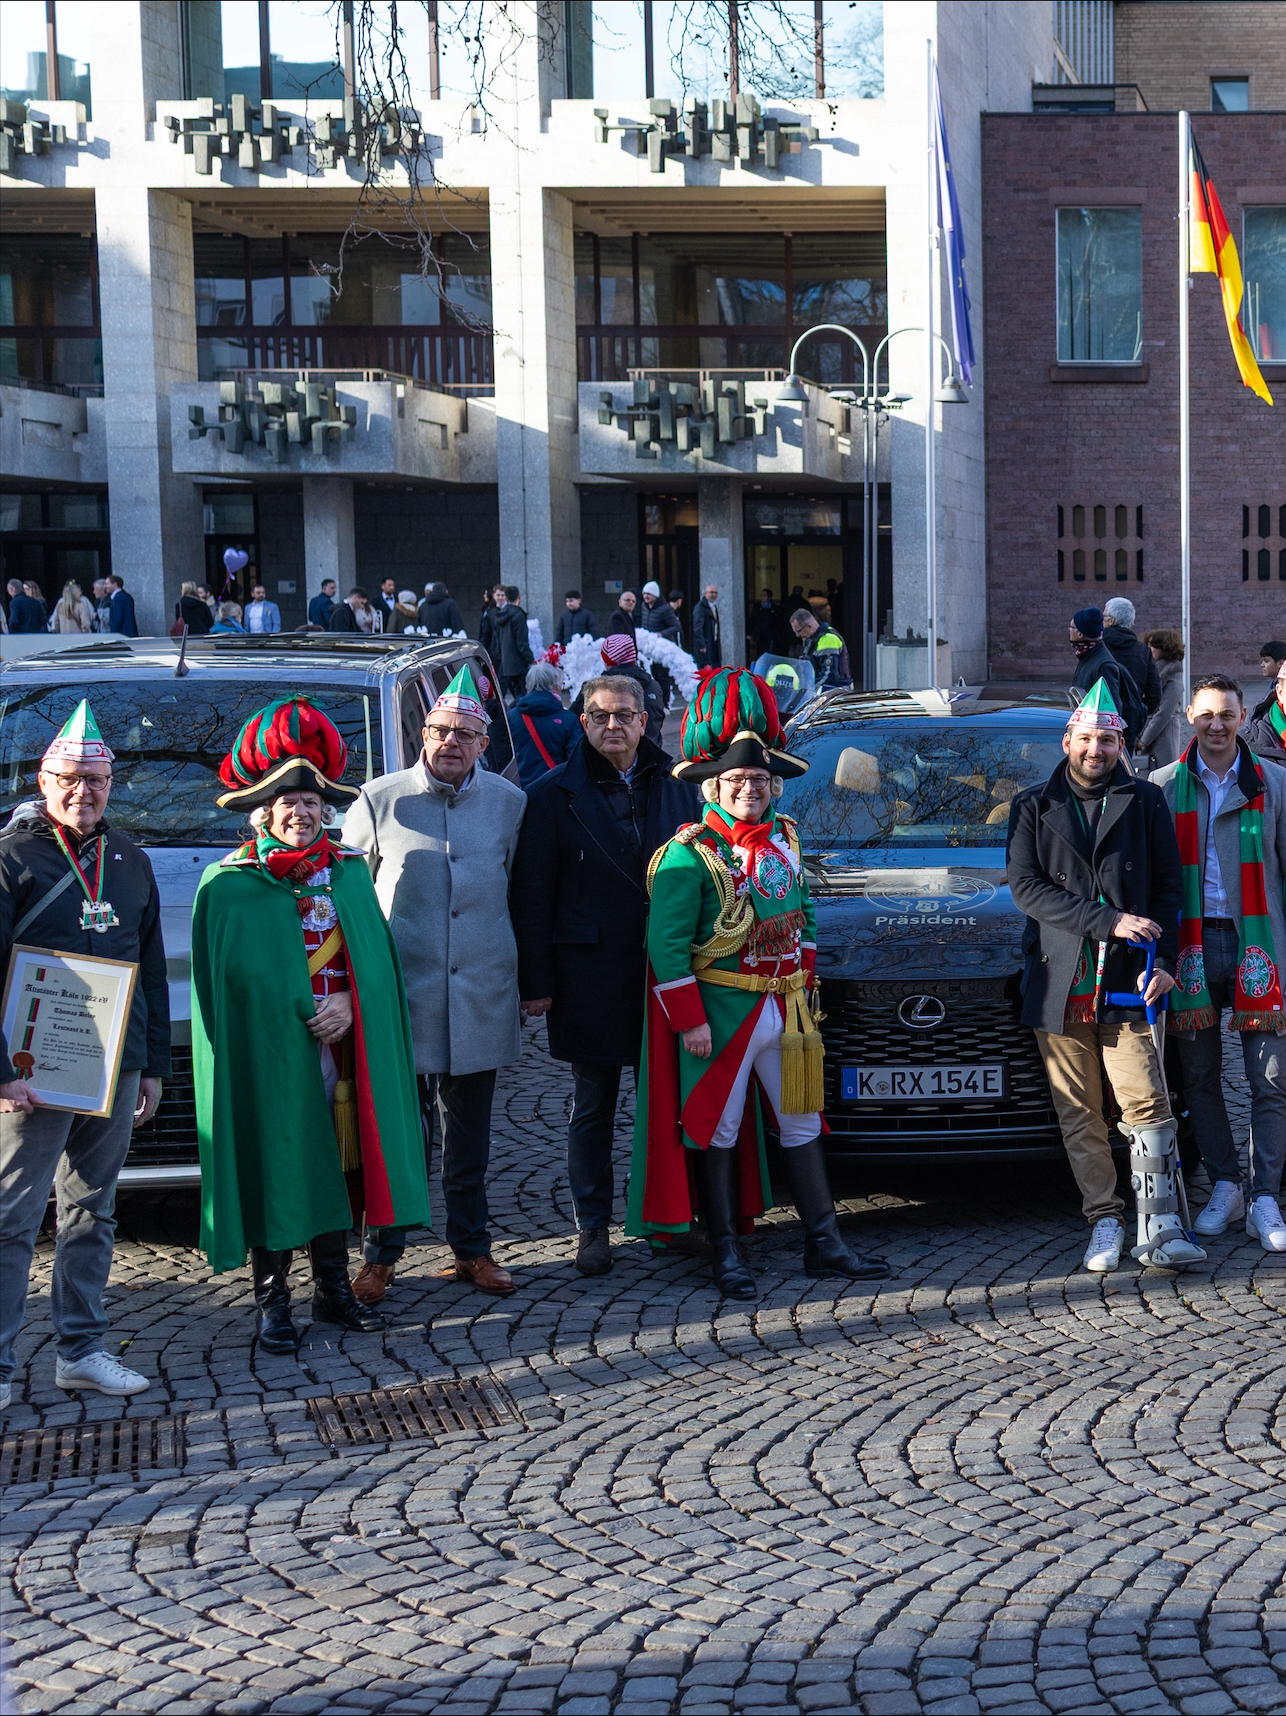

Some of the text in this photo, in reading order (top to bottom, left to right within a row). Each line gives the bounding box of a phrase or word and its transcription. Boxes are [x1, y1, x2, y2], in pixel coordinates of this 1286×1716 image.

[875, 914, 977, 926] Präsident
[81, 993, 97, 1003] 1922
[859, 1069, 999, 1095] K RX 154E
